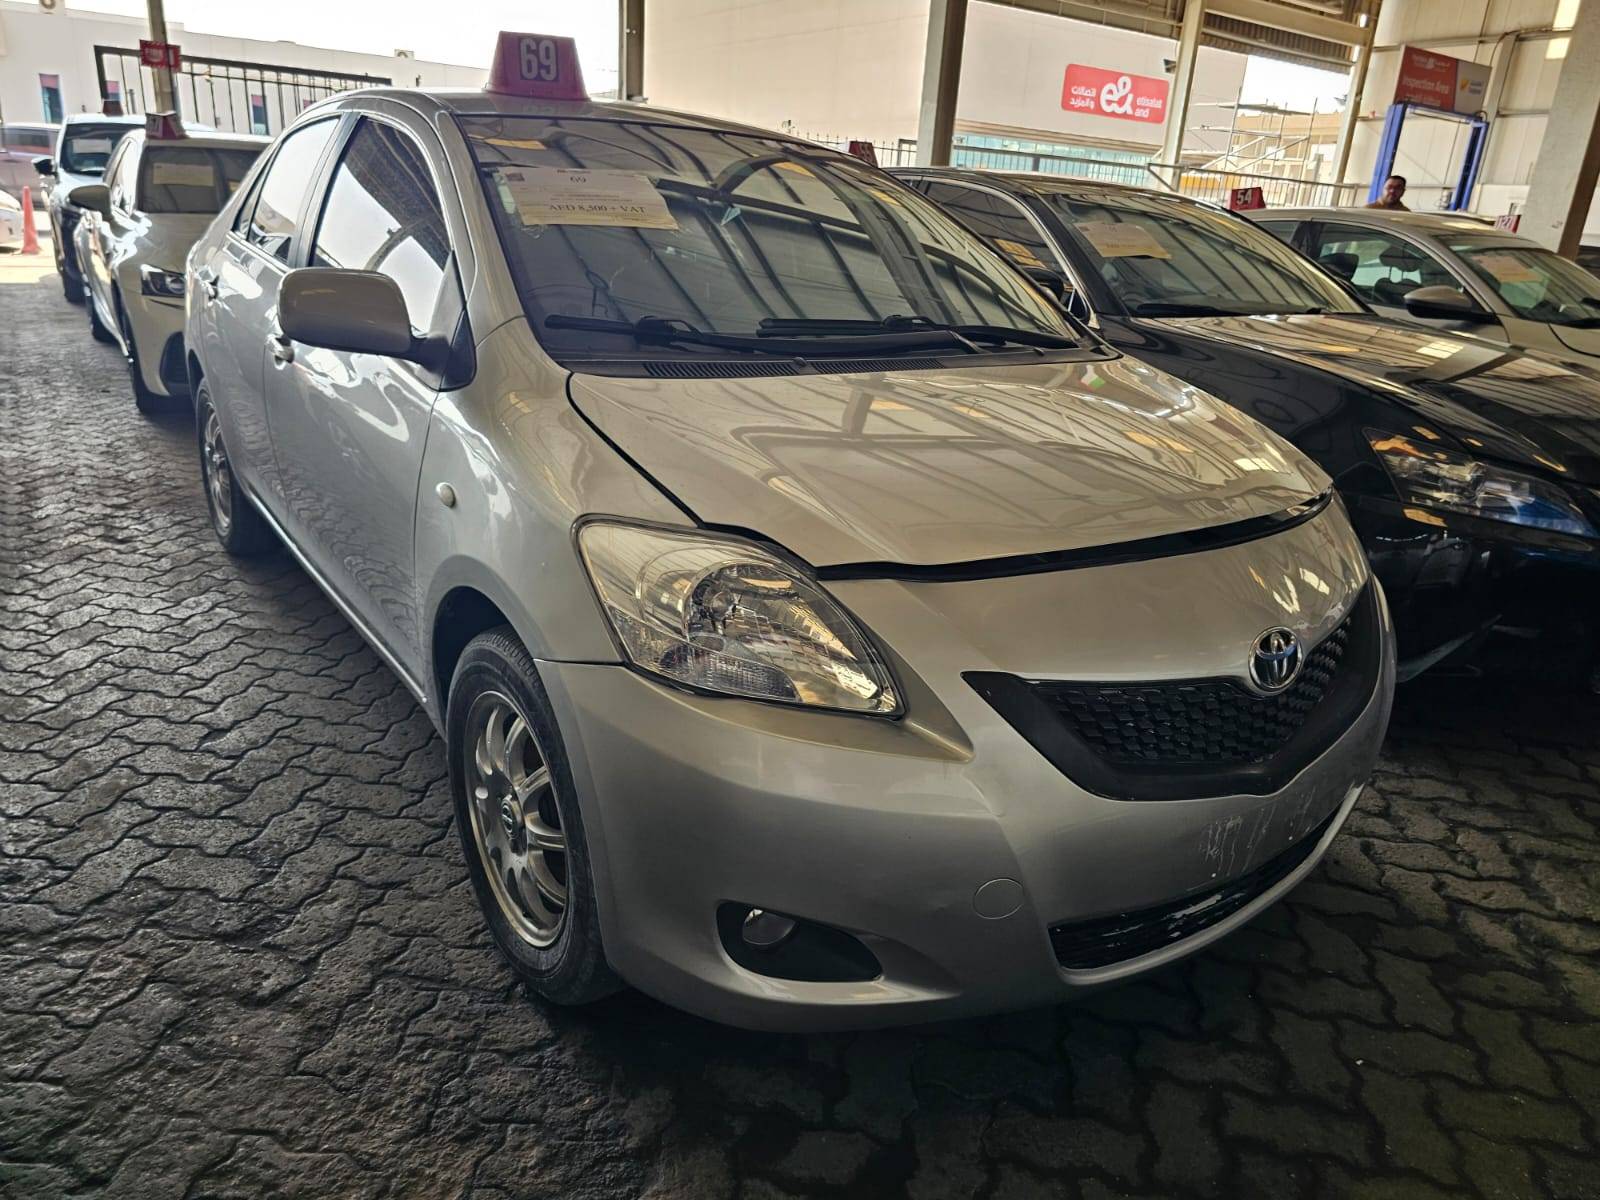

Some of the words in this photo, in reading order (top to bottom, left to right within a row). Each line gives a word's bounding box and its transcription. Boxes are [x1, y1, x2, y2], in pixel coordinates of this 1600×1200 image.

[520, 38, 556, 80] 69
[1136, 97, 1162, 109] etisalat
[1134, 108, 1150, 118] and
[1236, 189, 1252, 204] 54
[620, 205, 646, 213] VAT
